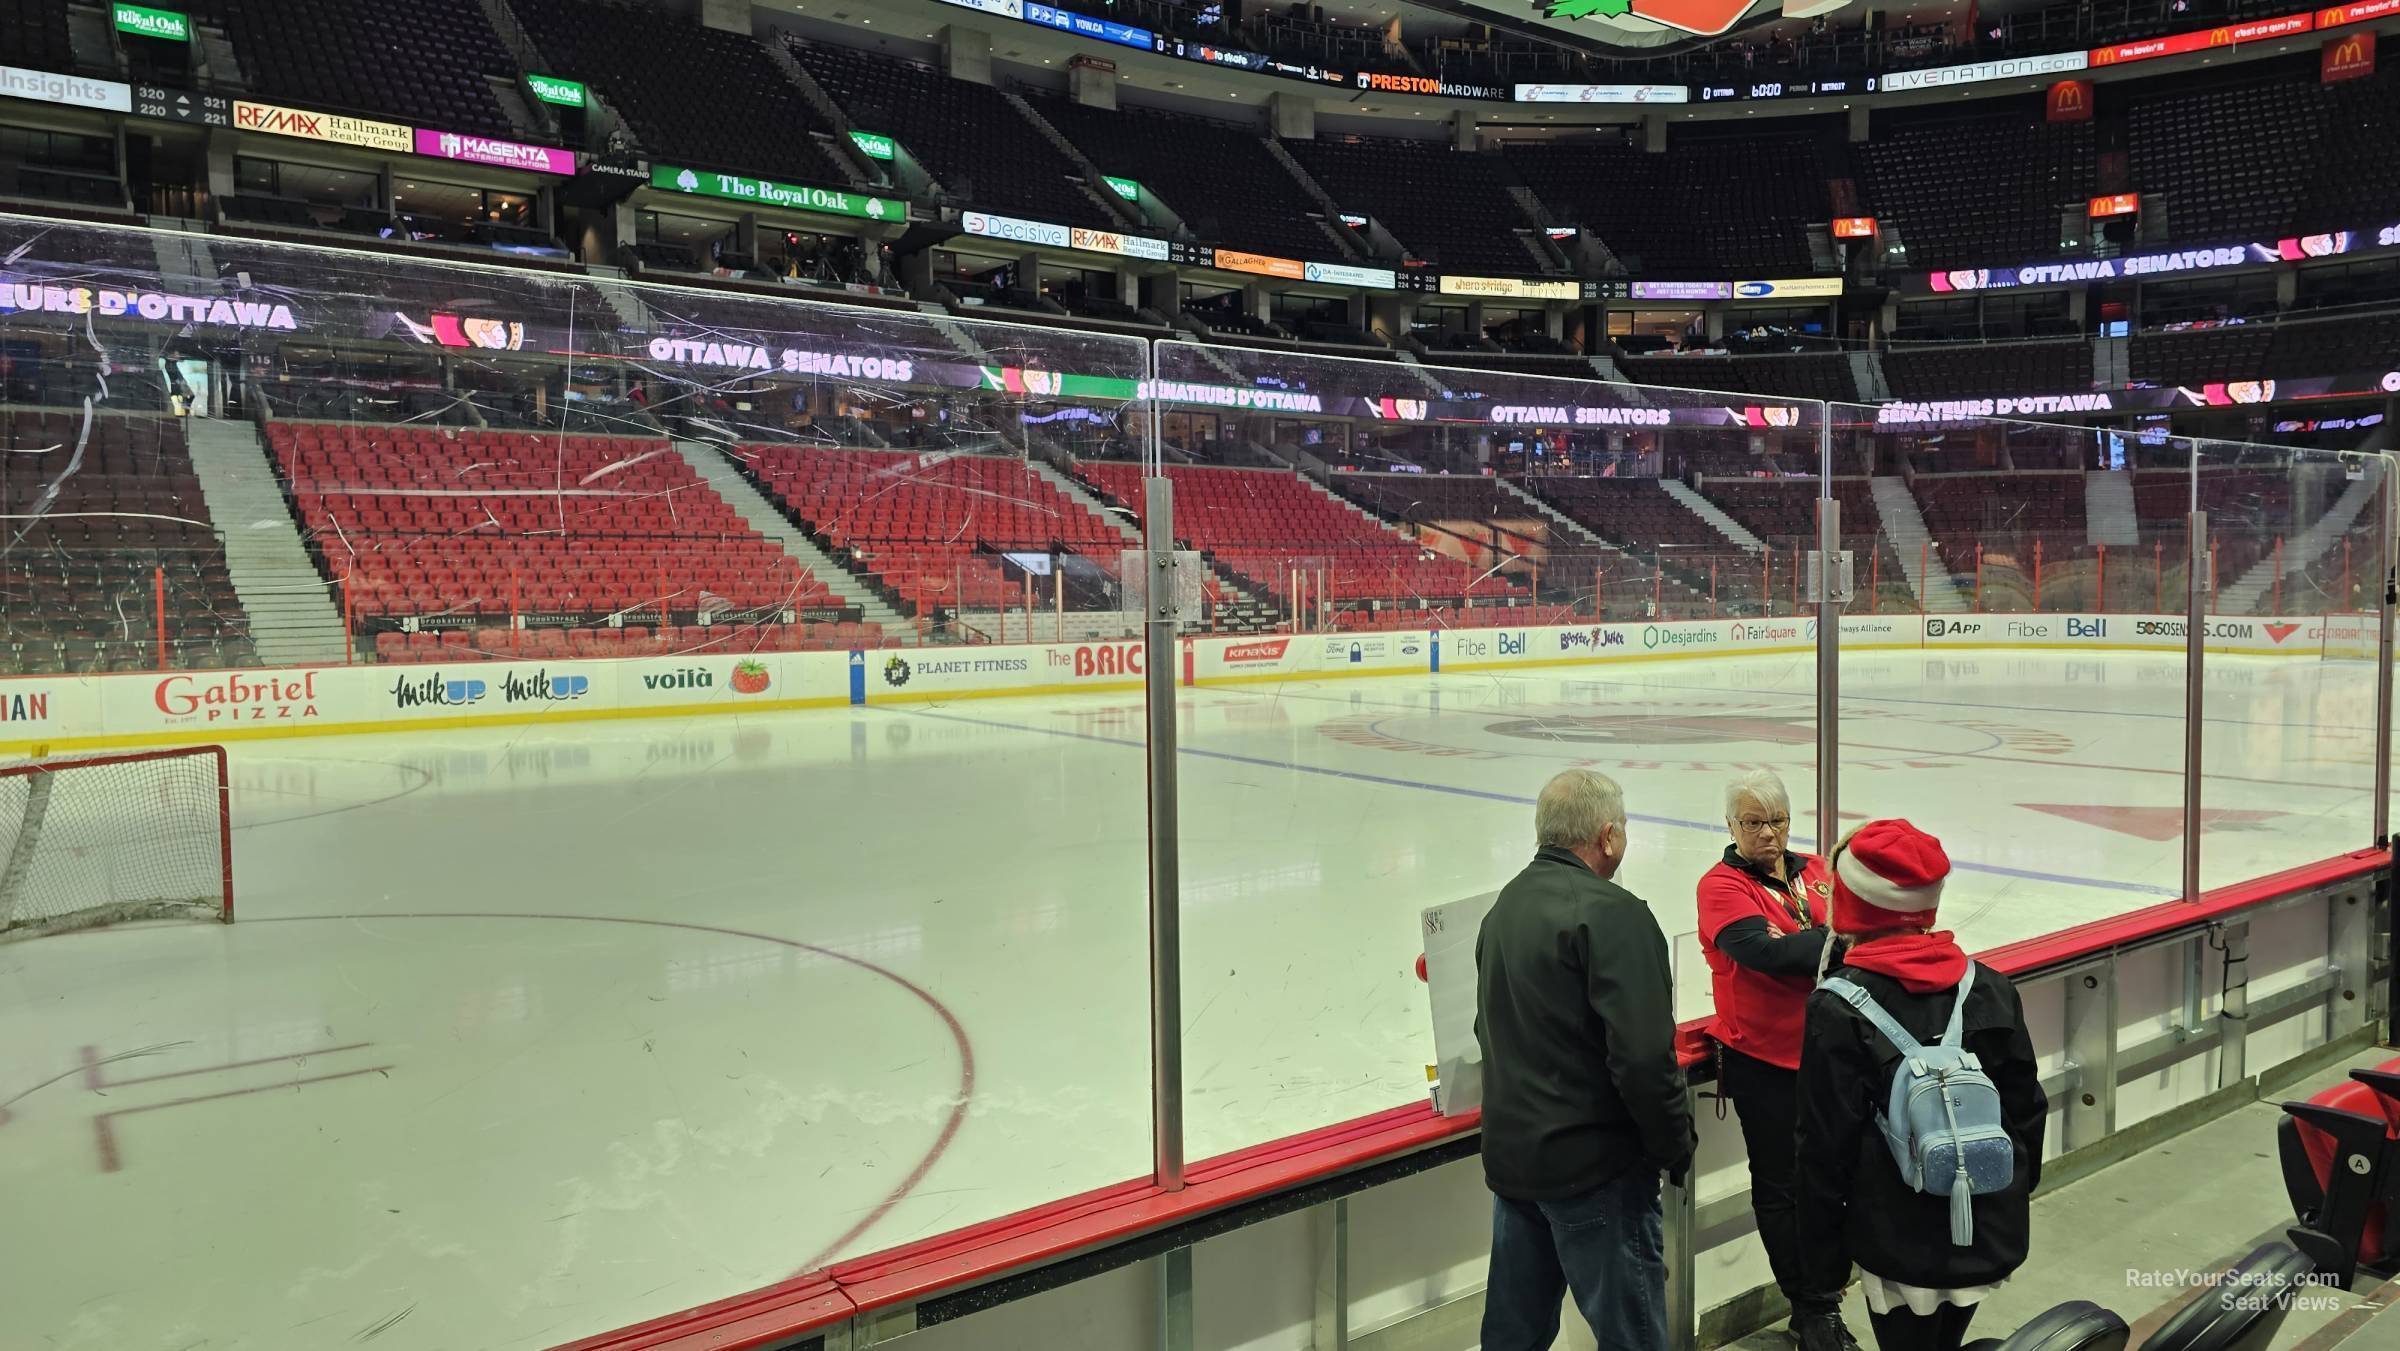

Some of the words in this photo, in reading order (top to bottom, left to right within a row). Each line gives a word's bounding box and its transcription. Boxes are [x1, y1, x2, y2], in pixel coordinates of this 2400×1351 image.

[117, 10, 153, 29] Royal
[155, 17, 185, 32] Oak
[1075, 19, 1103, 34] YOW.CA
[1887, 57, 2082, 88] LIVENATION.com
[0, 69, 107, 101] Insights
[560, 86, 581, 99] Oak
[1371, 74, 1440, 94] PRESTON
[1439, 83, 1504, 99] HARDWARE
[139, 87, 165, 101] 320
[204, 97, 226, 109] 321
[140, 103, 166, 116] 220
[204, 113, 226, 125] 221
[237, 106, 323, 137] RE/MAX
[330, 117, 408, 139] Hallmark
[330, 130, 370, 147] Realty
[373, 136, 409, 152] Group
[463, 138, 550, 162] MAGENTA
[464, 152, 504, 164] EXTERIOR
[506, 157, 551, 170] SOLUTIONS
[592, 164, 624, 176] CAMERA
[626, 169, 650, 179] STAND
[717, 174, 755, 196] The
[758, 181, 809, 206] Royal
[812, 189, 848, 210] Oak
[988, 217, 1063, 244] Decisive
[1073, 231, 1120, 251] RE/MAX
[1123, 236, 1167, 251] Hallmark
[1171, 242, 1185, 252] 323
[1200, 246, 1213, 256] 324
[1145, 248, 1168, 260] Group
[1171, 253, 1185, 263] 223
[1200, 257, 1213, 267] 224
[1225, 254, 1267, 267] GALLAGHER
[2019, 261, 2115, 286] OTTAWA
[2123, 246, 2246, 275] SENATORS
[1584, 282, 1597, 290] 325
[99, 291, 298, 330] D'OTTAWA
[250, 355, 271, 366] 115
[650, 337, 772, 370] OTTAWA
[782, 348, 912, 381] SENATORS
[1238, 389, 1322, 412] D'OTTAWA
[1996, 394, 2112, 415] D'OTTAWA
[1491, 405, 1569, 424] OTTAWA
[1576, 407, 1671, 425] SENATORS
[623, 613, 672, 621] brookstret
[2067, 617, 2106, 637] Bell
[1662, 630, 1717, 645] Desjardins
[1747, 627, 1797, 641] FairSquare
[1861, 624, 1892, 632] Alliance
[2008, 621, 2048, 637] Fibe
[1457, 638, 1486, 656] Fibe
[1499, 633, 1526, 655] Bell
[917, 660, 971, 674] PLANET
[974, 659, 1027, 673] FITNESS
[1047, 649, 1070, 666] The
[1075, 644, 1143, 676] BRIC
[154, 671, 319, 716] Gabriel
[208, 704, 318, 721] PIZZA
[2354, 1159, 2365, 1169] A
